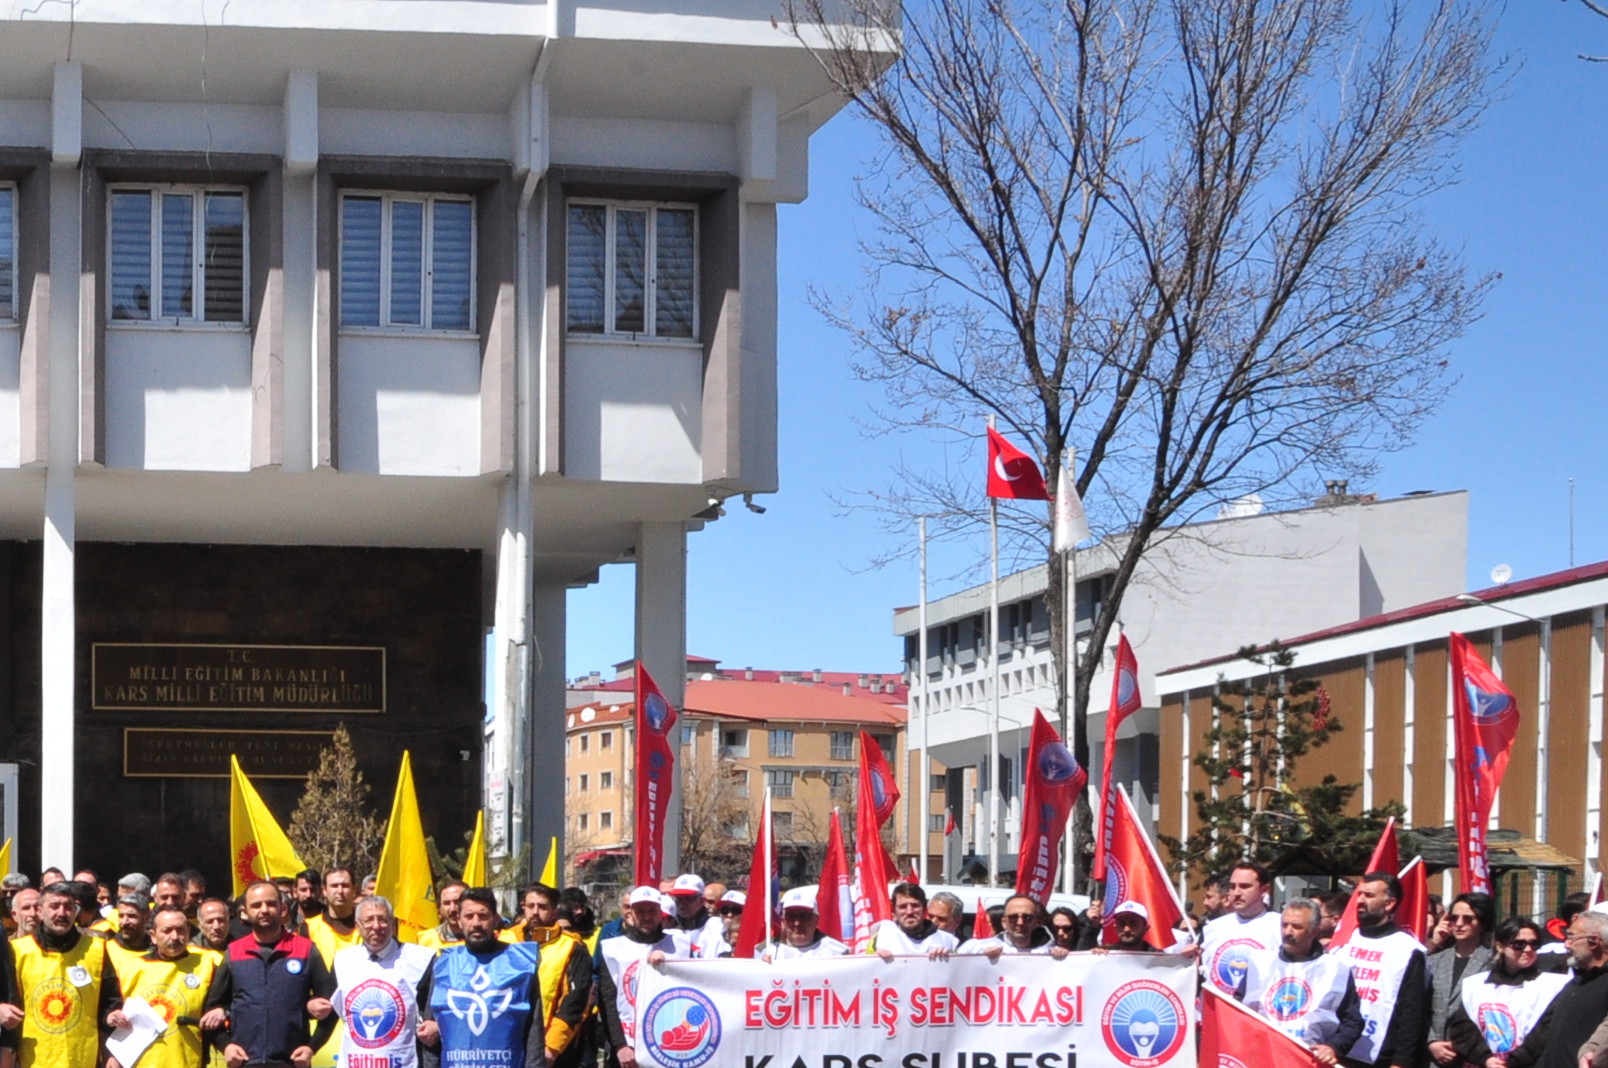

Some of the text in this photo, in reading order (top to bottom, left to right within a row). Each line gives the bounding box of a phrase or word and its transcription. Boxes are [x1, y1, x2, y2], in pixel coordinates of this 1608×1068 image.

[129, 664, 178, 681] MİLLİ
[185, 665, 243, 681] EĞİTİM
[104, 685, 148, 701] KARS
[156, 683, 201, 702] MİLLİ
[1350, 946, 1383, 962] EMEK
[745, 978, 861, 1028] EĞİTİM
[872, 977, 900, 1038] İŞ
[909, 975, 1085, 1026] SENDİKASI
[447, 1048, 512, 1064] HÜRRİYETÇİ
